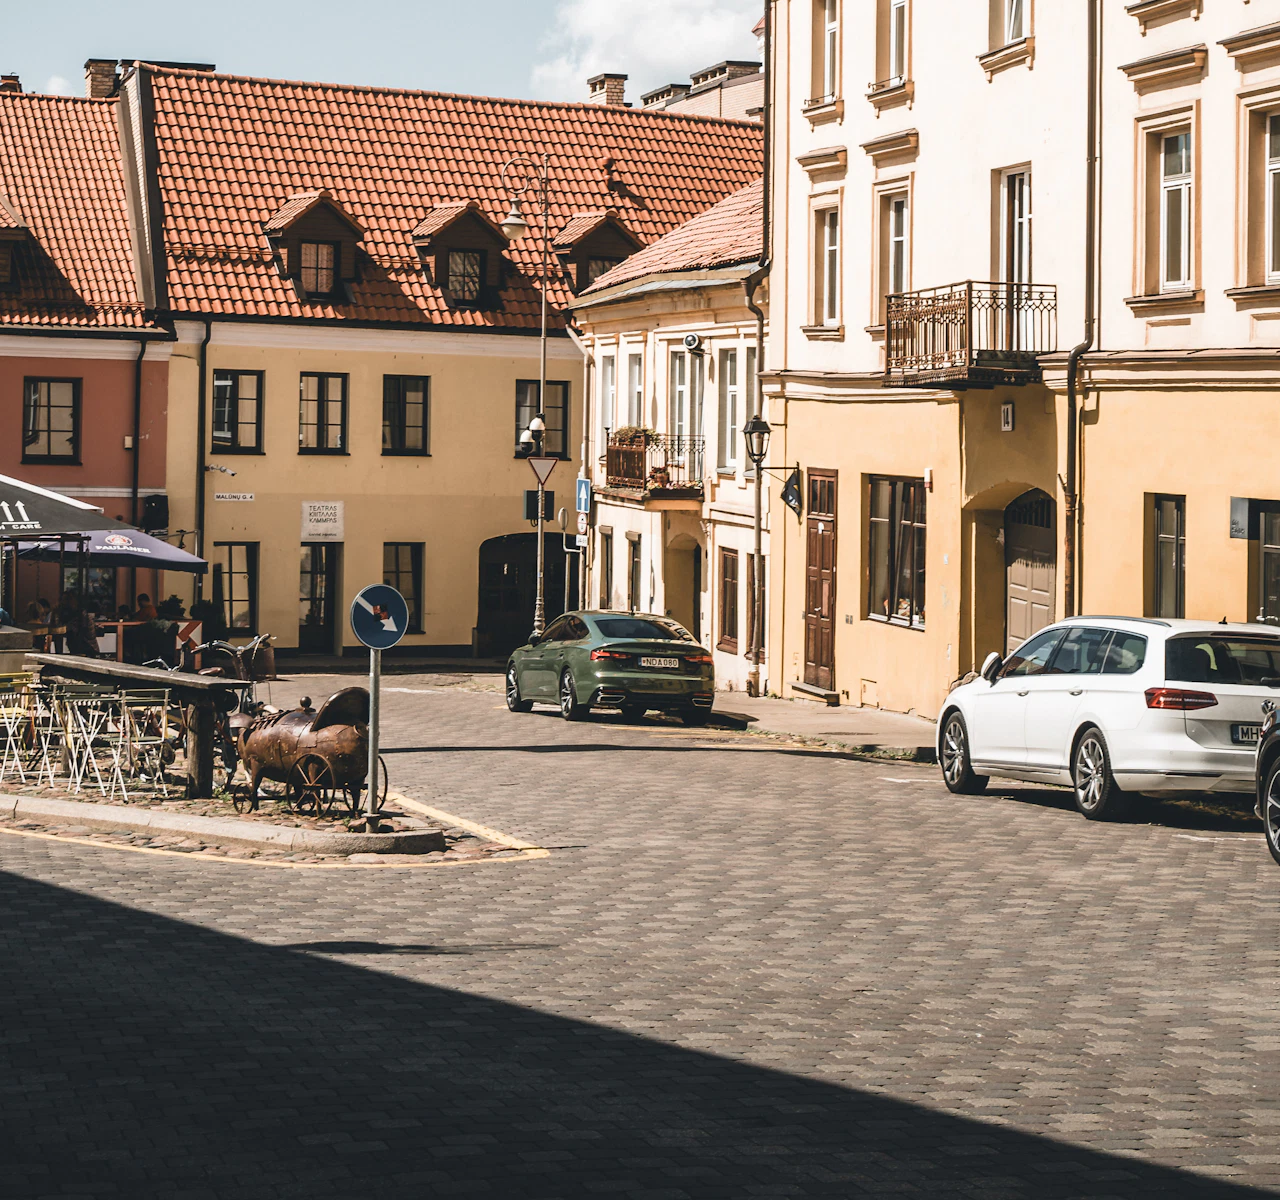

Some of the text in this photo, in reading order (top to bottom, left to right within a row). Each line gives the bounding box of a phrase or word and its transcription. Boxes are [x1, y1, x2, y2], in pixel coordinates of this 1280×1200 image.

[1003, 407, 1010, 428] 14
[215, 493, 241, 501] MALŪNŲ
[94, 544, 152, 554] PAULANER
[1241, 726, 1264, 740] MH
